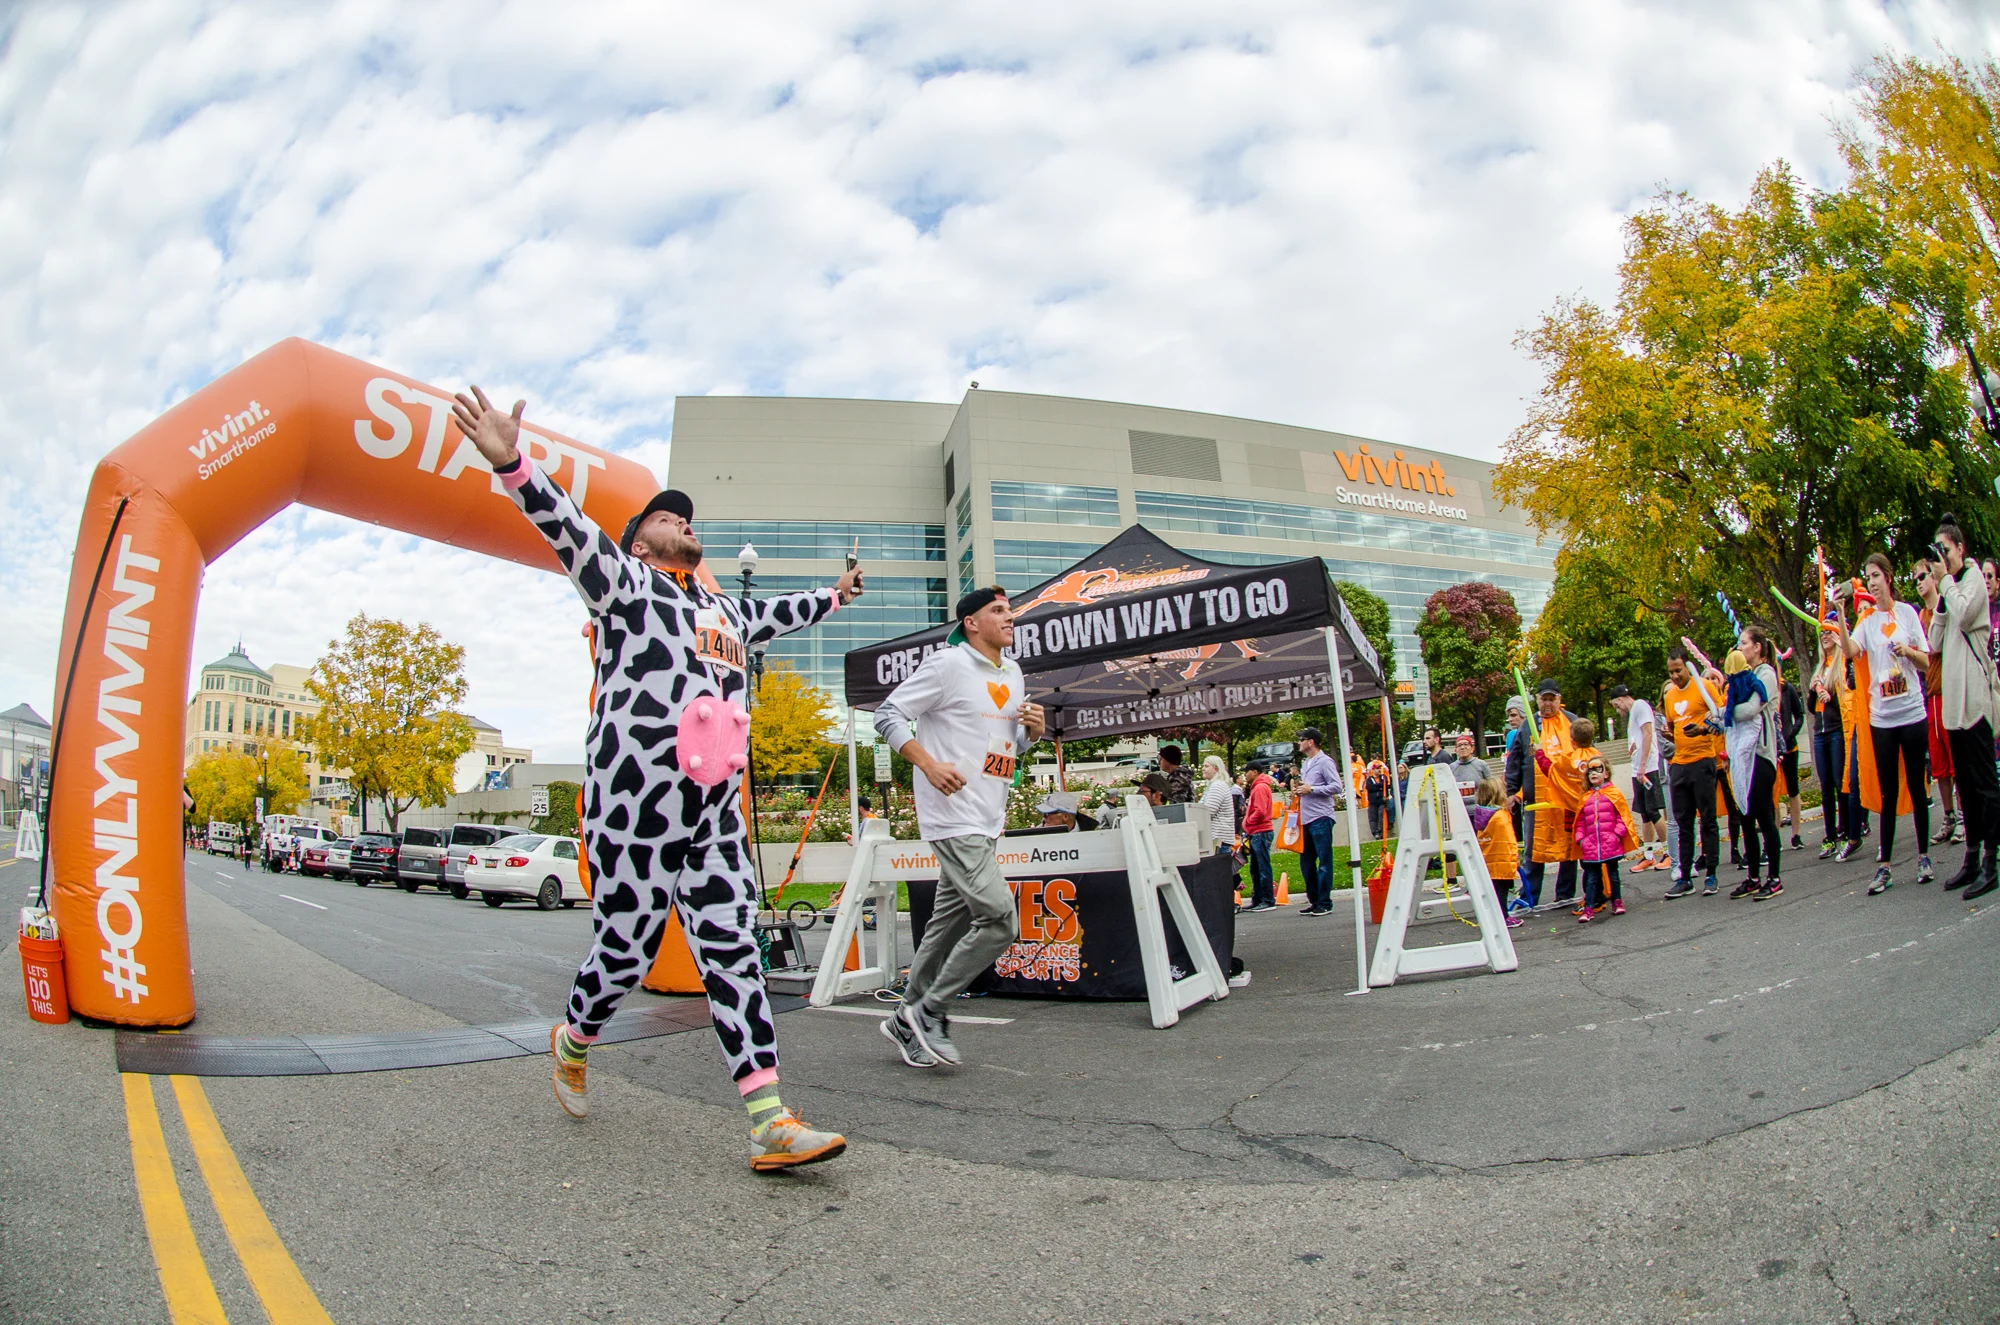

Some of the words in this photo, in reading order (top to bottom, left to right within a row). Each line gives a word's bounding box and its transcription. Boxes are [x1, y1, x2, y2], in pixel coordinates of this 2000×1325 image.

[188, 400, 270, 459] vivint.
[198, 421, 277, 480] SmartHome
[1333, 444, 1455, 497] vivint.
[1335, 486, 1427, 514] SmartHome
[1428, 500, 1467, 520] Arena
[1044, 607, 1117, 652] OWN
[1119, 593, 1193, 640] WAY
[1199, 586, 1240, 626] TO
[1244, 578, 1289, 619] GO
[700, 630, 743, 666] 1400
[94, 534, 160, 1004] #ONLYVIVINT
[533, 803, 547, 813] 25
[1031, 847, 1079, 863] Arena
[27, 963, 48, 978] LET'S
[994, 956, 1080, 982] SPORTS
[29, 976, 51, 1000] DO
[31, 999, 56, 1015] THIS.
